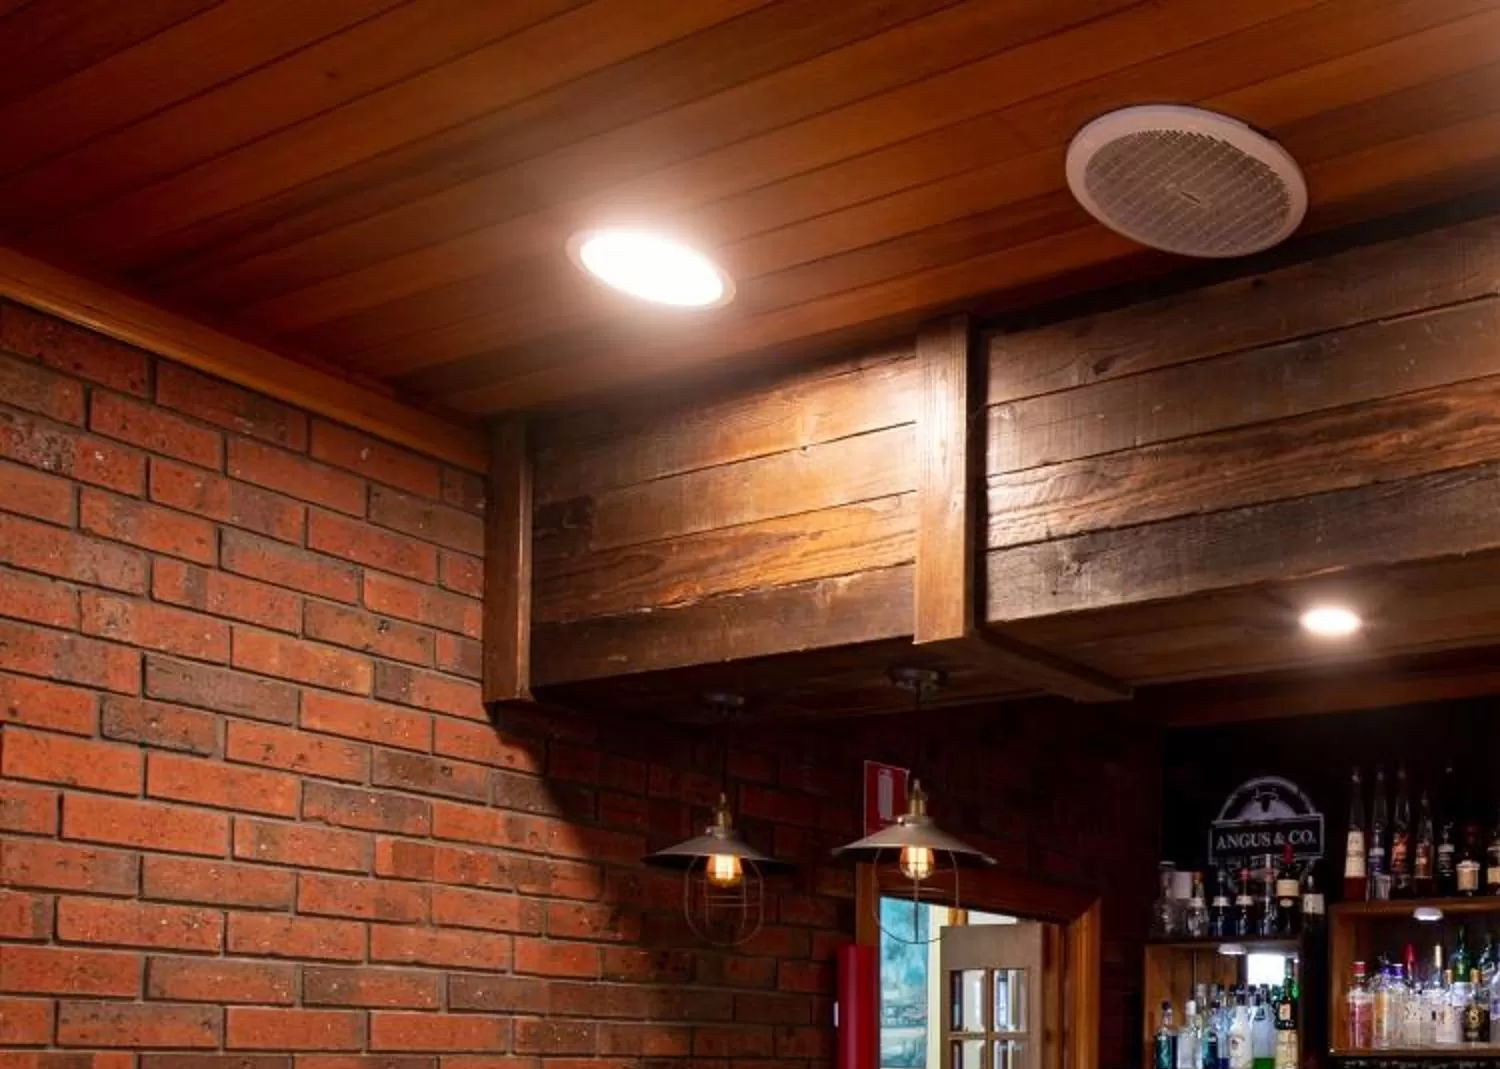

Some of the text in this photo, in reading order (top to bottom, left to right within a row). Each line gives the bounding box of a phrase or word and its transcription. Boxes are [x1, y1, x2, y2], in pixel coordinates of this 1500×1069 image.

[1216, 829, 1317, 849] ANGUS & CO.
